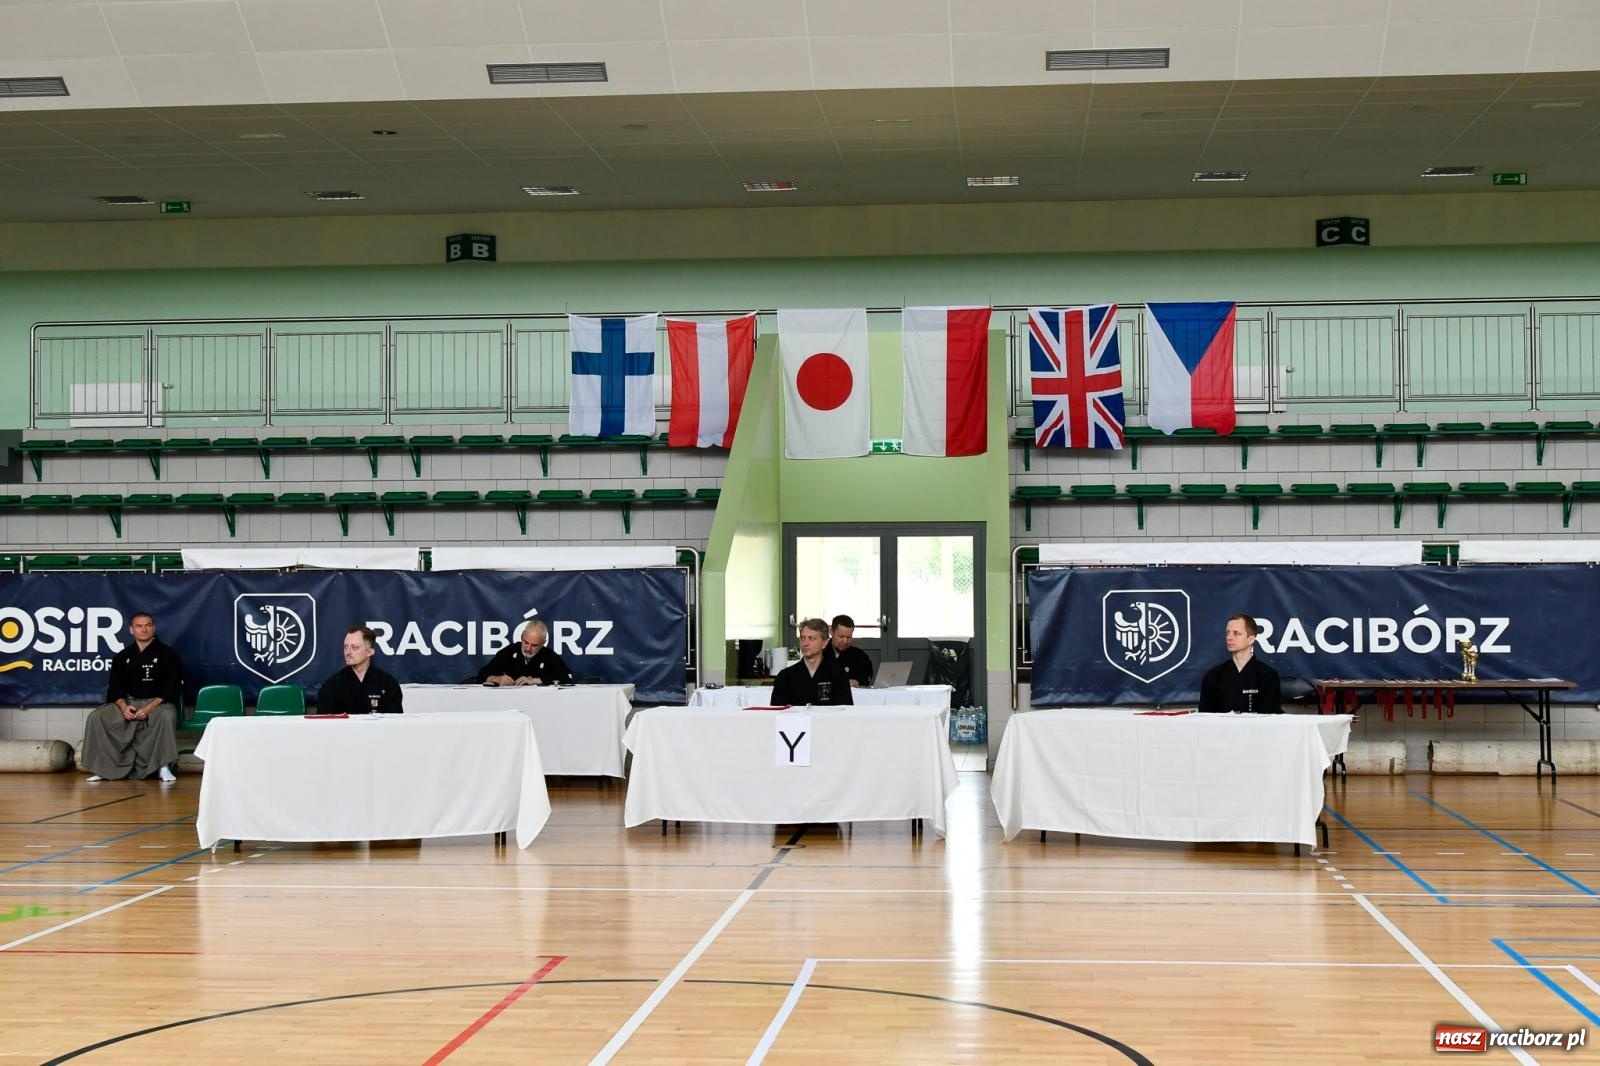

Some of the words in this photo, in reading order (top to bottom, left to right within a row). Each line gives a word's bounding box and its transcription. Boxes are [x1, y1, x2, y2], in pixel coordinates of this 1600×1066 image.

[1321, 226, 1340, 243] C
[1351, 225, 1366, 242] C
[450, 243, 462, 259] B
[472, 242, 490, 258] B
[1252, 603, 1512, 654] RACIBÓRZ
[42, 654, 113, 672] RACIBÓR
[778, 730, 807, 763] Y
